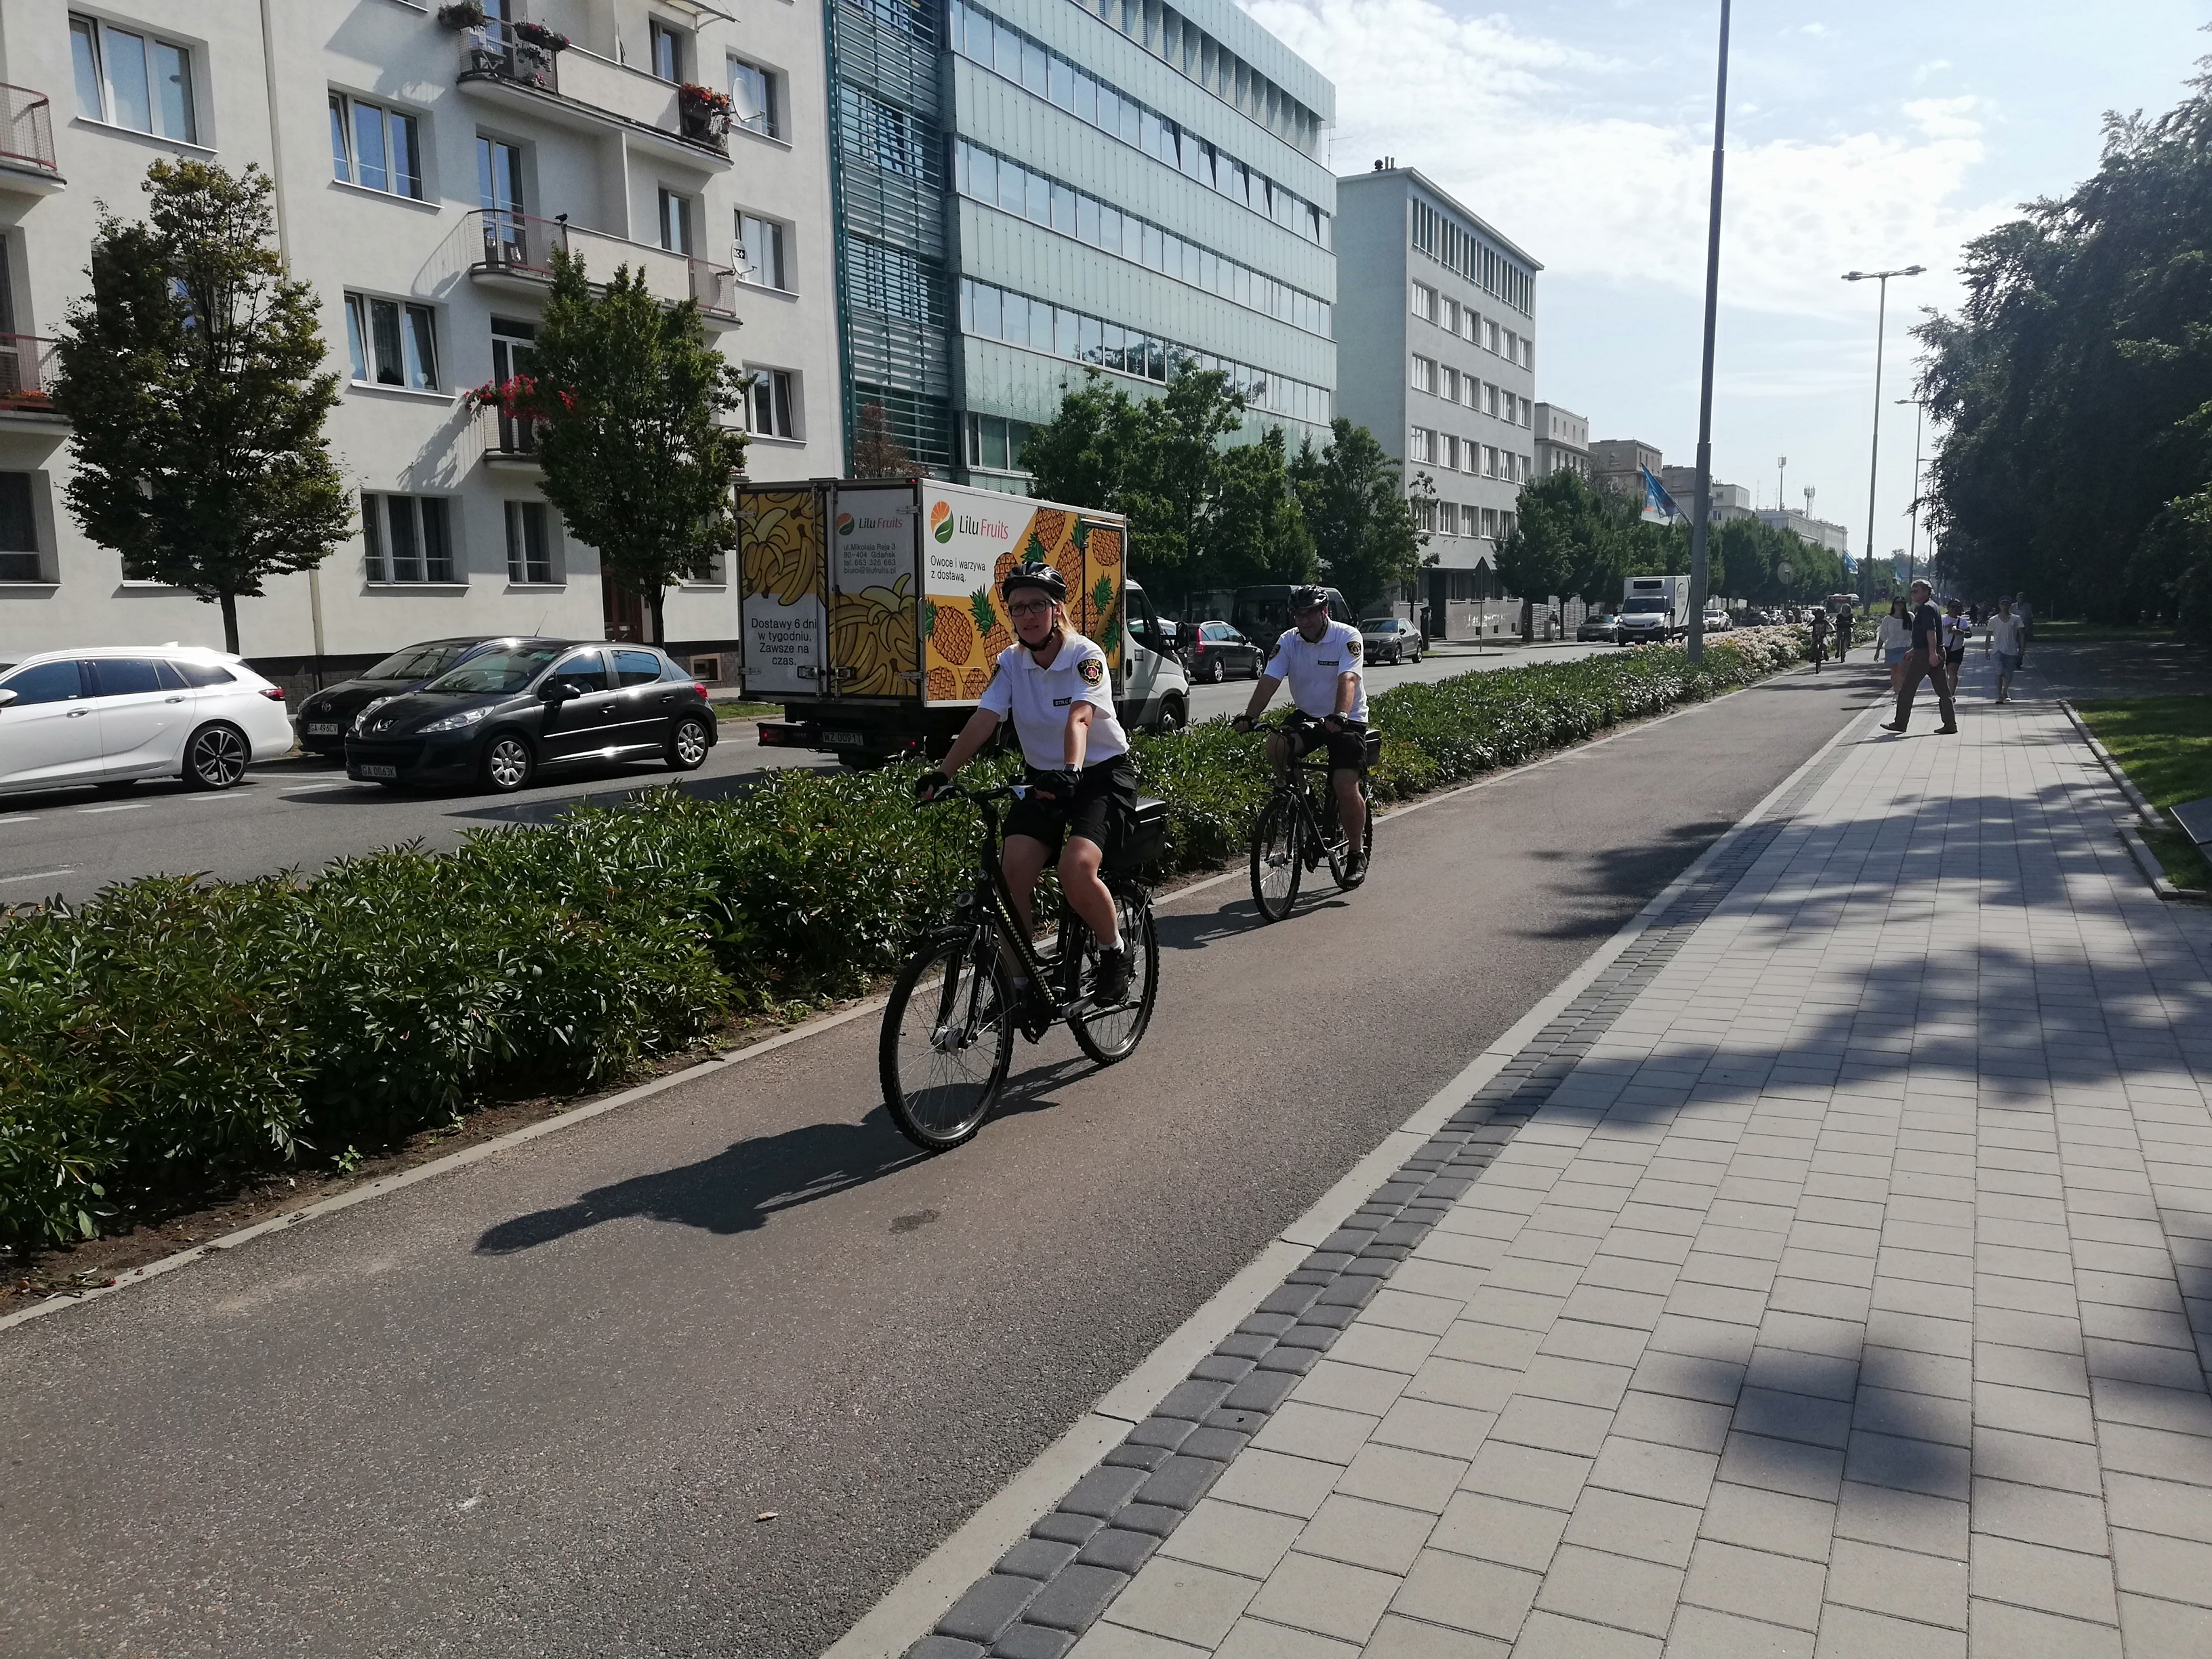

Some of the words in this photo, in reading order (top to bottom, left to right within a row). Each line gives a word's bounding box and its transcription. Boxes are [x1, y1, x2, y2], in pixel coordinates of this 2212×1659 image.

[859, 518, 876, 529] Lilu
[877, 517, 903, 529] Fruits
[959, 515, 979, 535] Lilu
[981, 518, 1008, 539] Fruits
[930, 555, 953, 568] Owoce
[958, 560, 986, 571] warzywa
[930, 570, 935, 579] z
[937, 569, 966, 583] dostawą.
[751, 618, 792, 630] Dostawy
[794, 618, 800, 628] 6
[802, 619, 817, 629] dni
[758, 632, 766, 640] w
[769, 631, 812, 642] tygodniu.
[759, 642, 794, 653] Zawsze
[798, 645, 809, 653] na
[772, 657, 796, 665] czas.
[823, 733, 836, 742] WZ
[838, 733, 862, 743] 0091T
[362, 766, 373, 775] GA
[373, 766, 395, 777] 0063K
